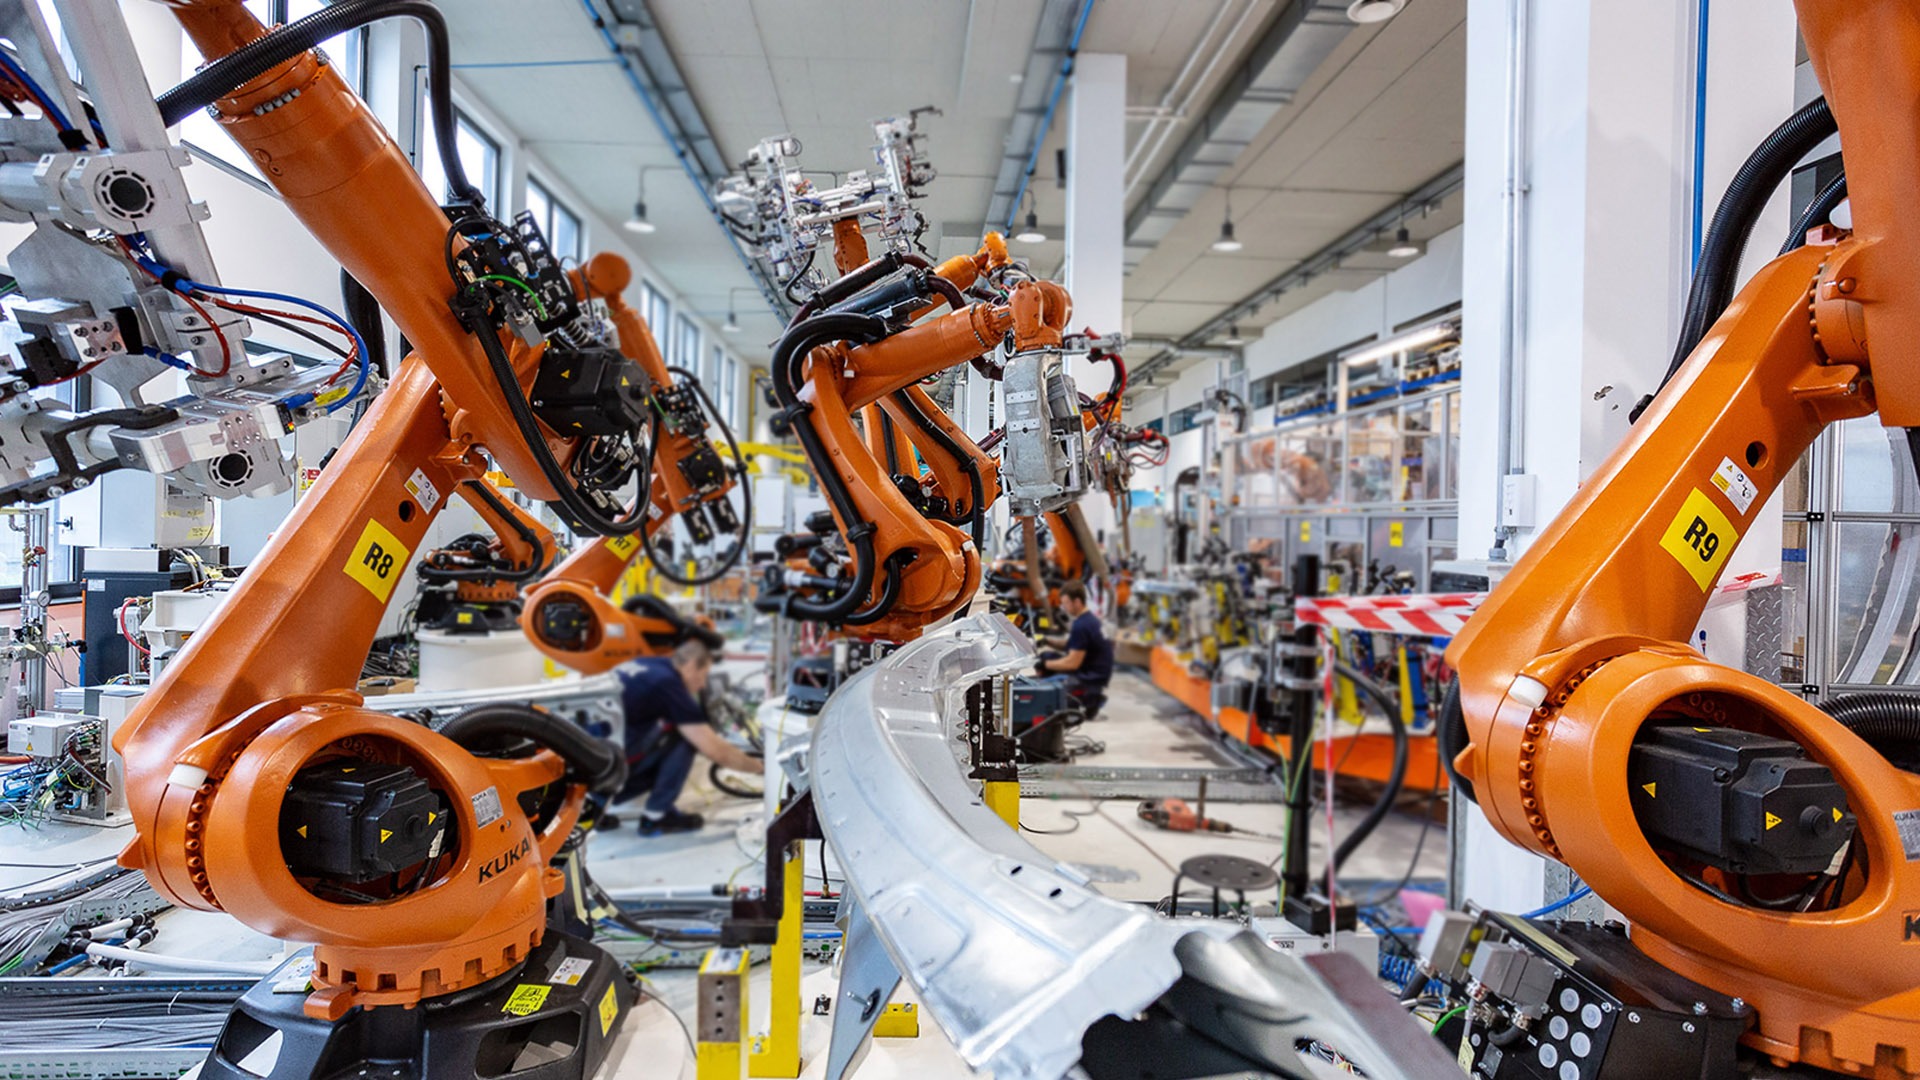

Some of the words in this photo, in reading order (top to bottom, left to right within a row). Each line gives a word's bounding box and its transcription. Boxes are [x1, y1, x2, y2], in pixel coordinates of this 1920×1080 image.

[362, 541, 394, 579] R8
[1683, 515, 1720, 562] R9
[478, 837, 531, 884] KUKA
